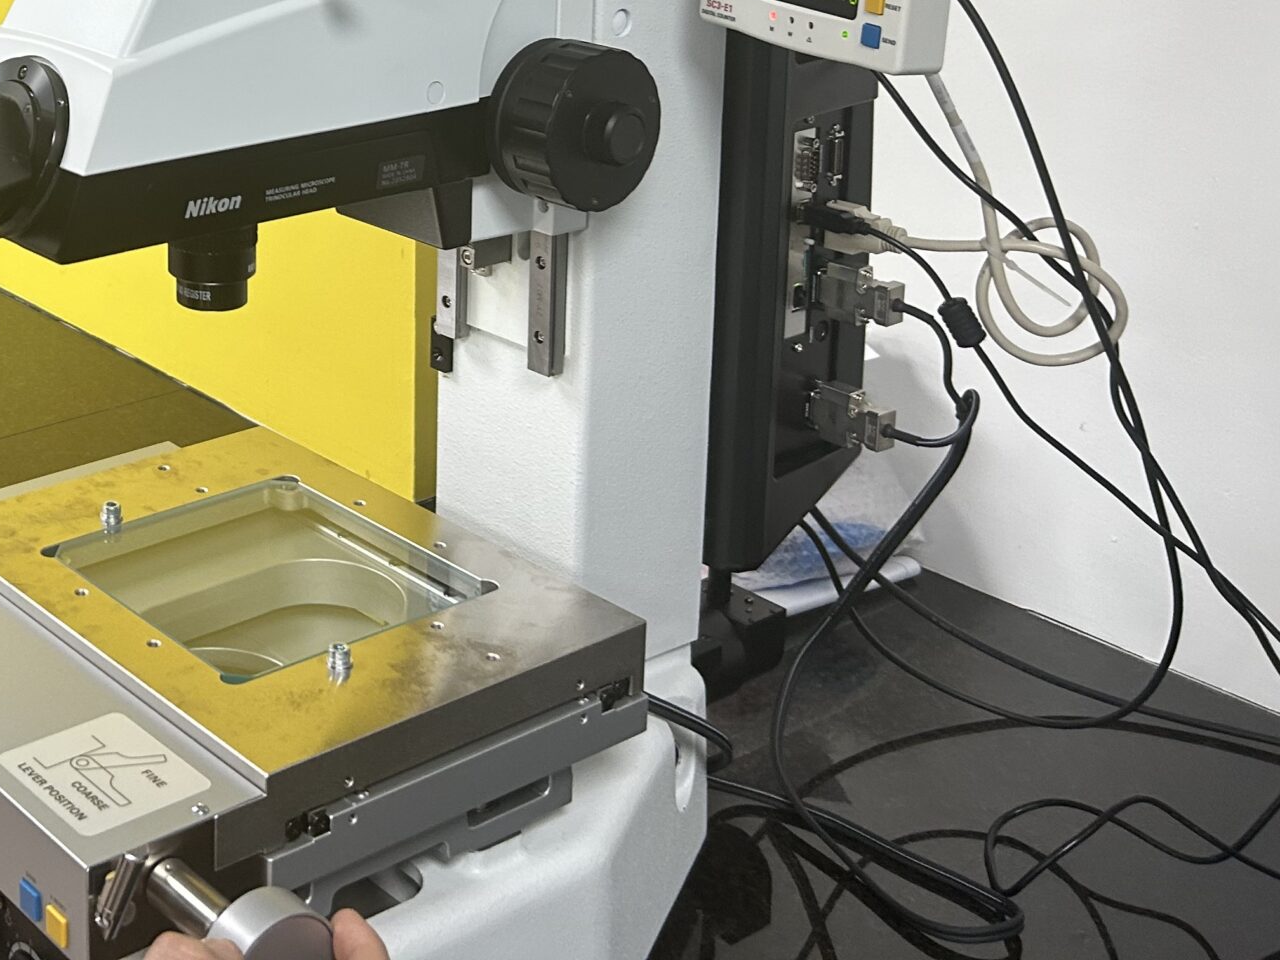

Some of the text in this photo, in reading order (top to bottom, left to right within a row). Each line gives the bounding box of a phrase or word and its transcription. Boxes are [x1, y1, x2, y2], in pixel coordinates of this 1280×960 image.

[716, 12, 736, 22] COUNTER
[885, 3, 901, 12] RESET
[882, 37, 896, 46] SEND
[265, 176, 336, 196] MEASURING MICROSCOPE
[265, 186, 317, 202] TRINOCULAR HEAD
[184, 194, 242, 219] Nikon
[141, 769, 168, 788] FINE
[17, 762, 88, 822] LEVER POSITION
[71, 780, 110, 812] COARSE
